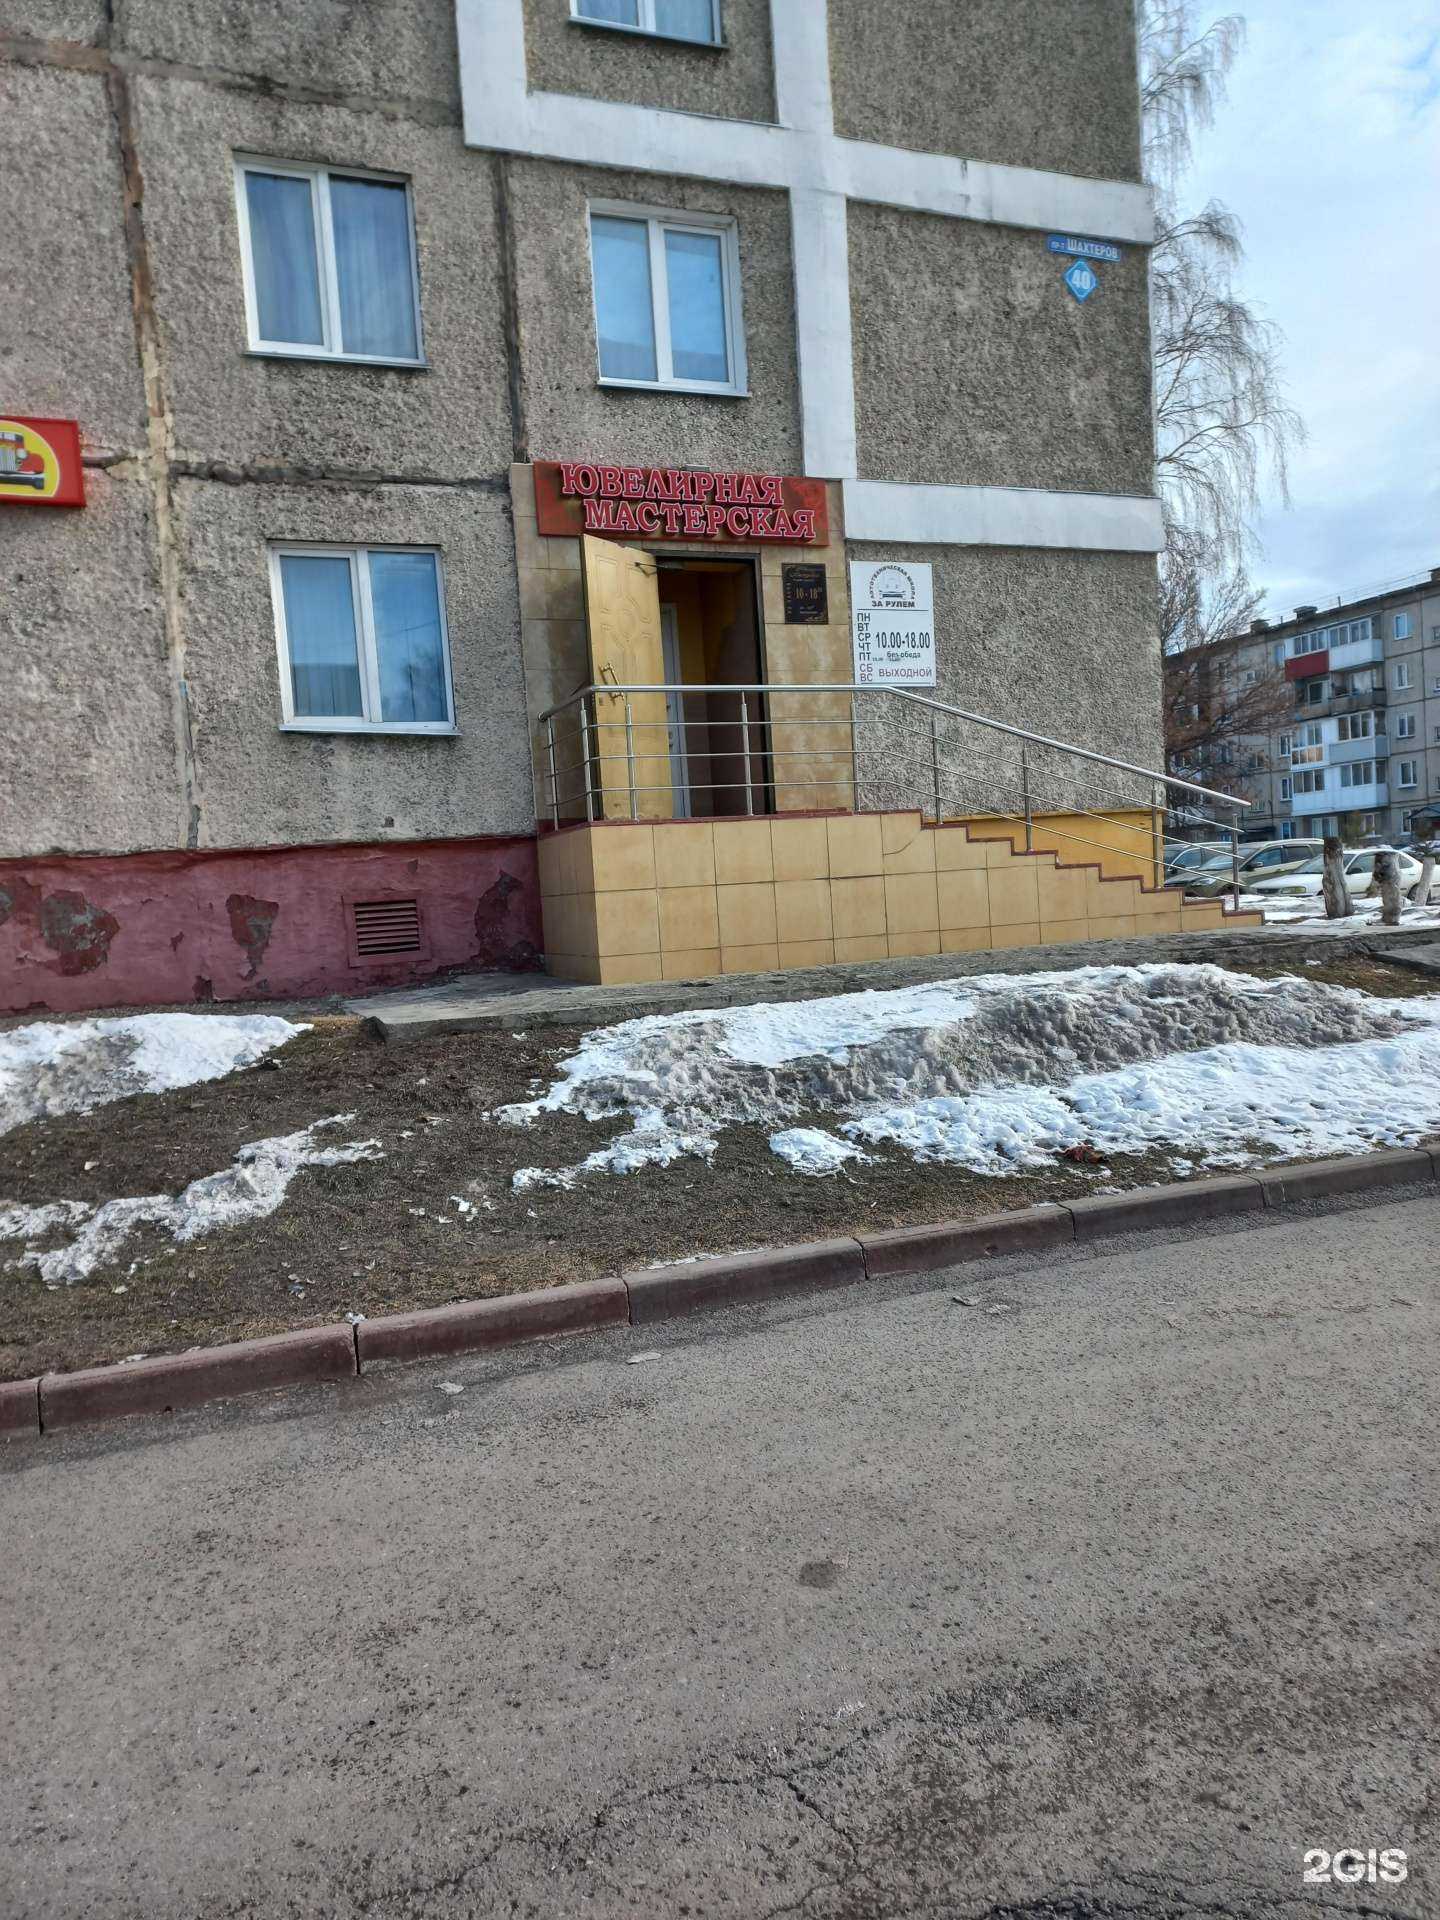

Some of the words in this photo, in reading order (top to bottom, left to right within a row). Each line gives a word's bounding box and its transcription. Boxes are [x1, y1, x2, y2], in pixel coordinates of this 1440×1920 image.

[1067, 238, 1118, 258] ШАХТЕРОВ
[1071, 269, 1091, 290] 40
[560, 463, 785, 505] ЮВЕЛИРНАЯ
[583, 498, 817, 539] МАСТЕРСКАЯ
[871, 600, 884, 608] ЗА
[885, 600, 916, 609] РУЛЕМ
[857, 612, 871, 622] ПН
[857, 622, 870, 632] ВТ
[858, 632, 871, 642] СР
[875, 631, 931, 649] 10.00-18.00
[859, 642, 871, 652] ЧТ
[859, 652, 871, 661] ПТ
[900, 651, 921, 660] обеда
[860, 663, 873, 673] СБ
[878, 667, 933, 679] ВЫХОДНОЙ
[860, 673, 873, 682] ВС
